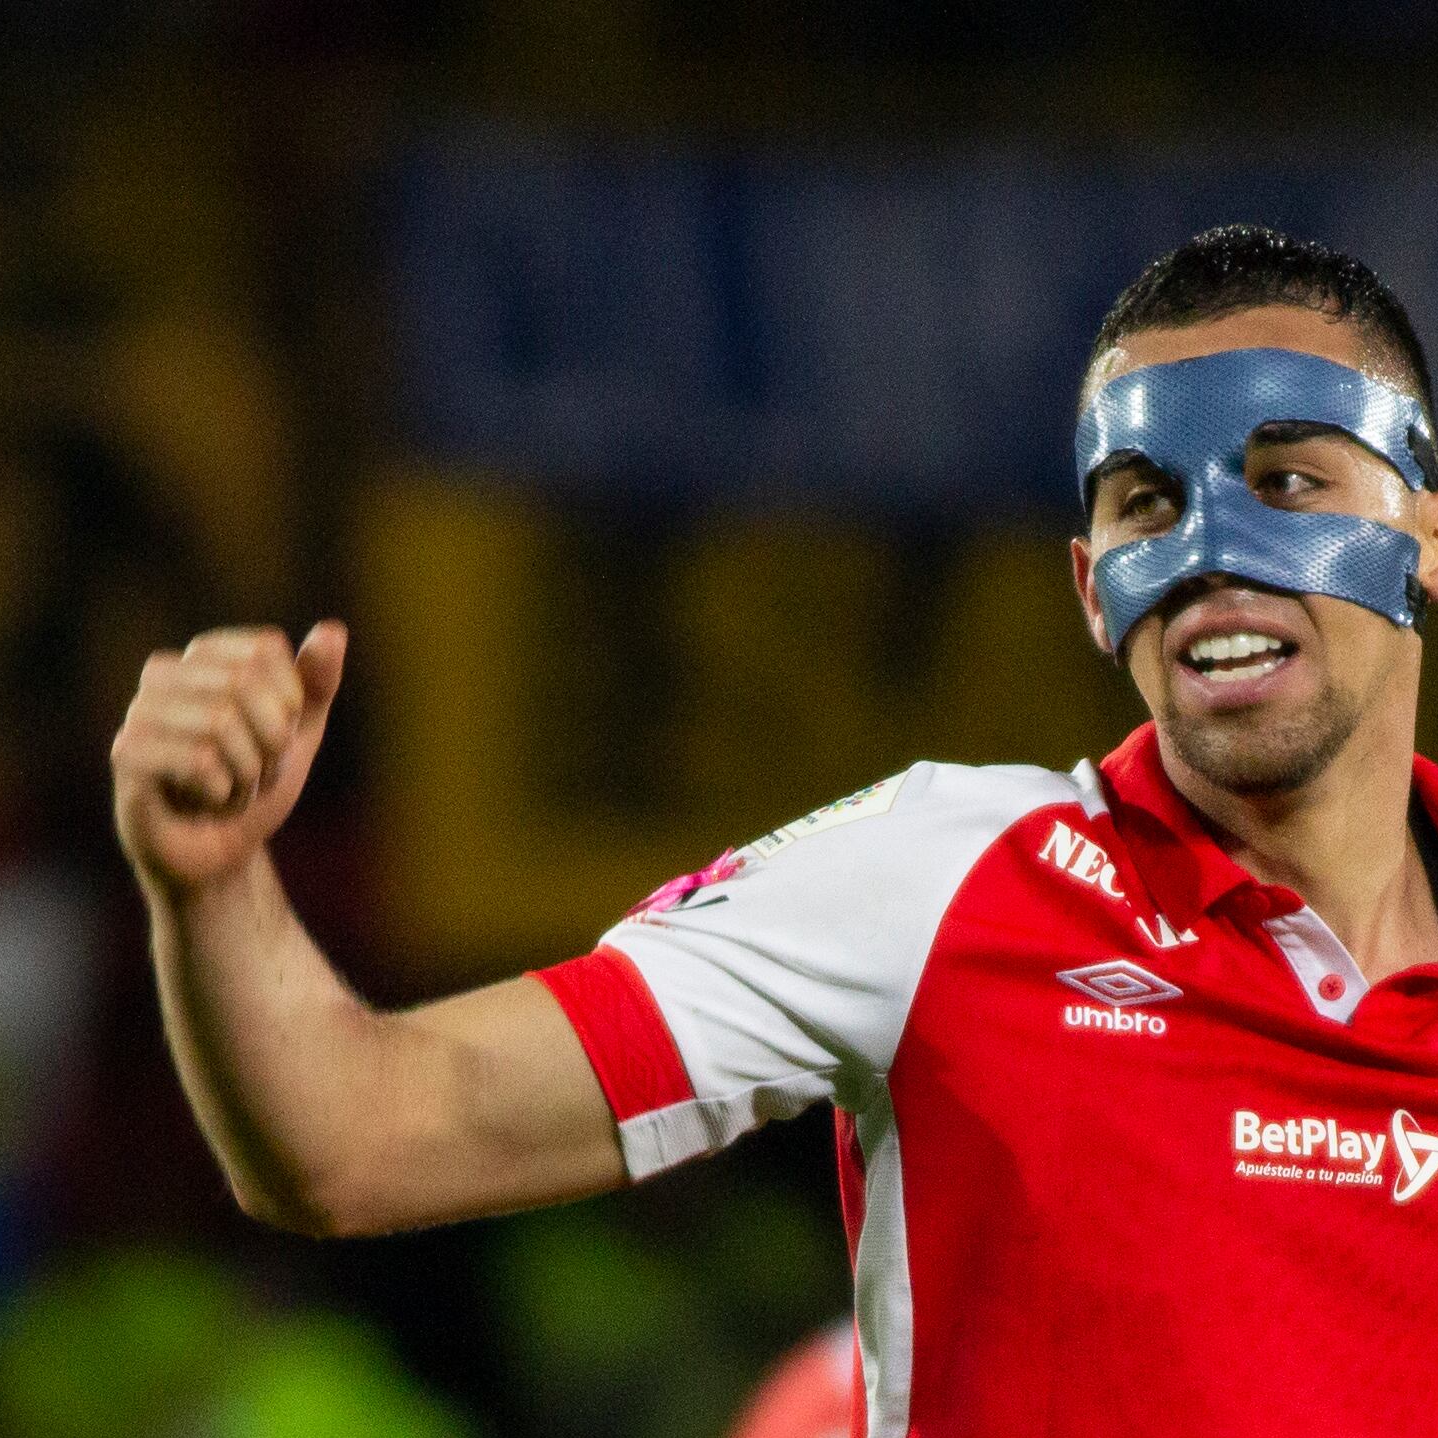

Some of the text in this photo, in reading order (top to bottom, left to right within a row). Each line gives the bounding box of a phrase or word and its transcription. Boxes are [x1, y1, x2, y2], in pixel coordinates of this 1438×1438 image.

[1064, 1006, 1167, 1035] umbro
[1234, 1110, 1387, 1171] BetPlay
[1236, 1160, 1383, 1185] Apuéstale a tu pasión
